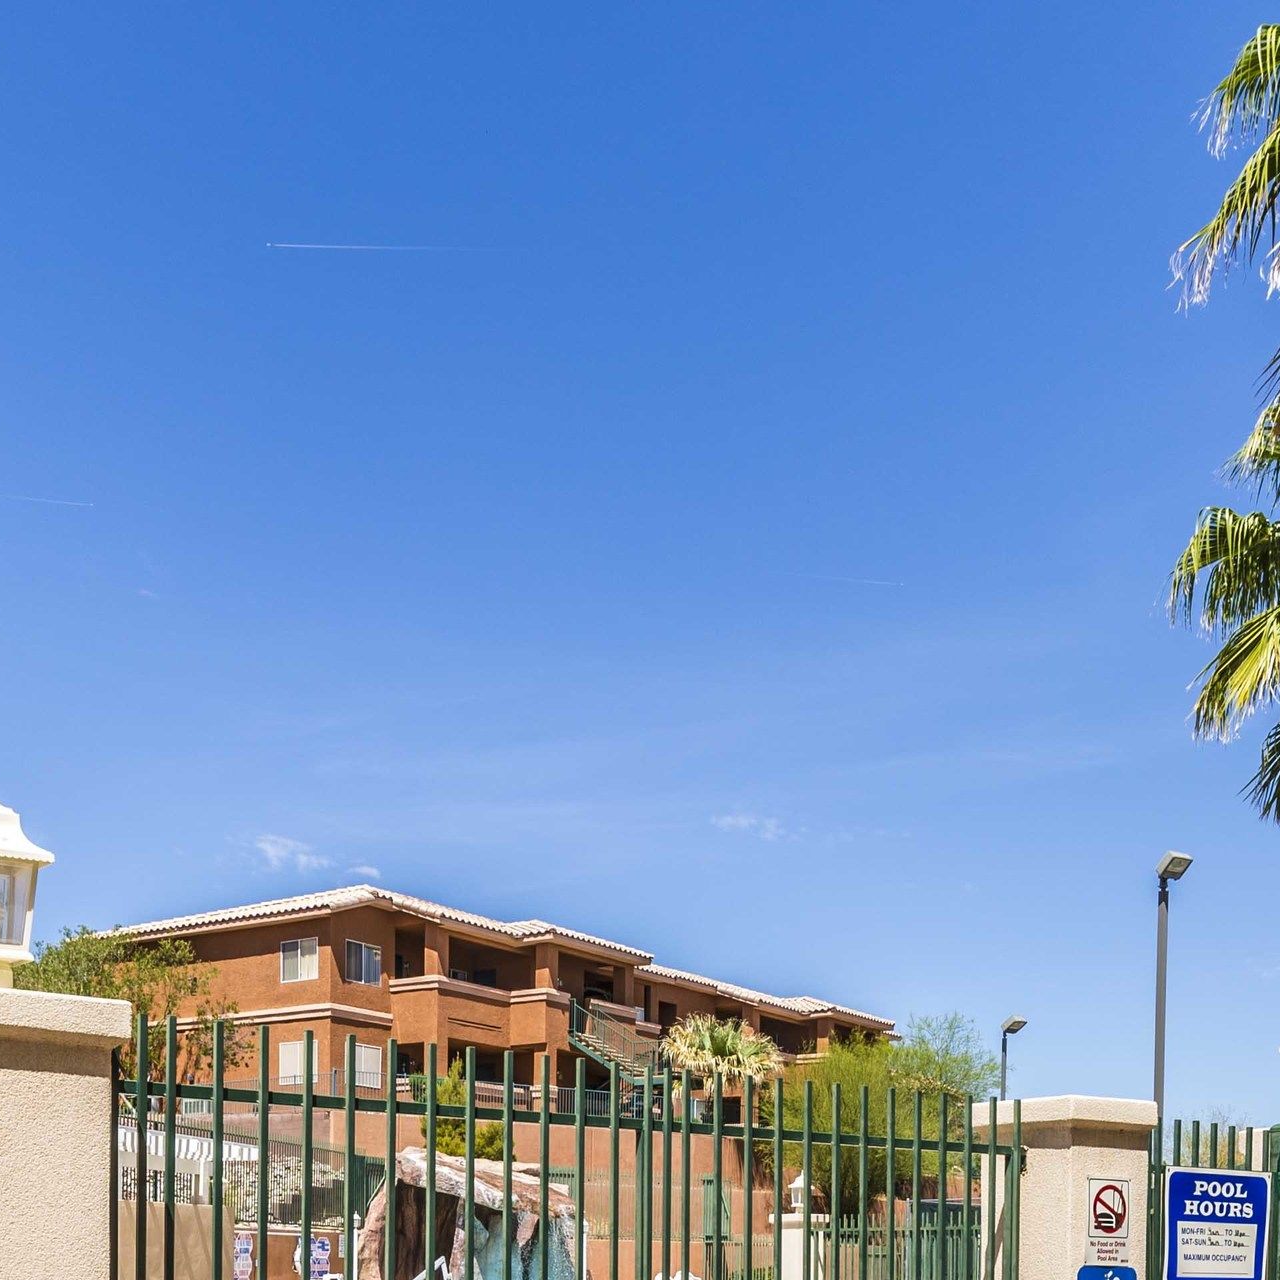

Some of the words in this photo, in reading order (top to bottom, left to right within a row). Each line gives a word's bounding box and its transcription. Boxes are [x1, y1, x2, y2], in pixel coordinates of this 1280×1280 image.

[1193, 1180, 1247, 1198] POOL
[1184, 1200, 1253, 1218] HOURS
[1181, 1227, 1206, 1235] MON-FRI
[1181, 1237, 1206, 1245] SAT-SUN
[1212, 1254, 1247, 1262] OCCUPANCY
